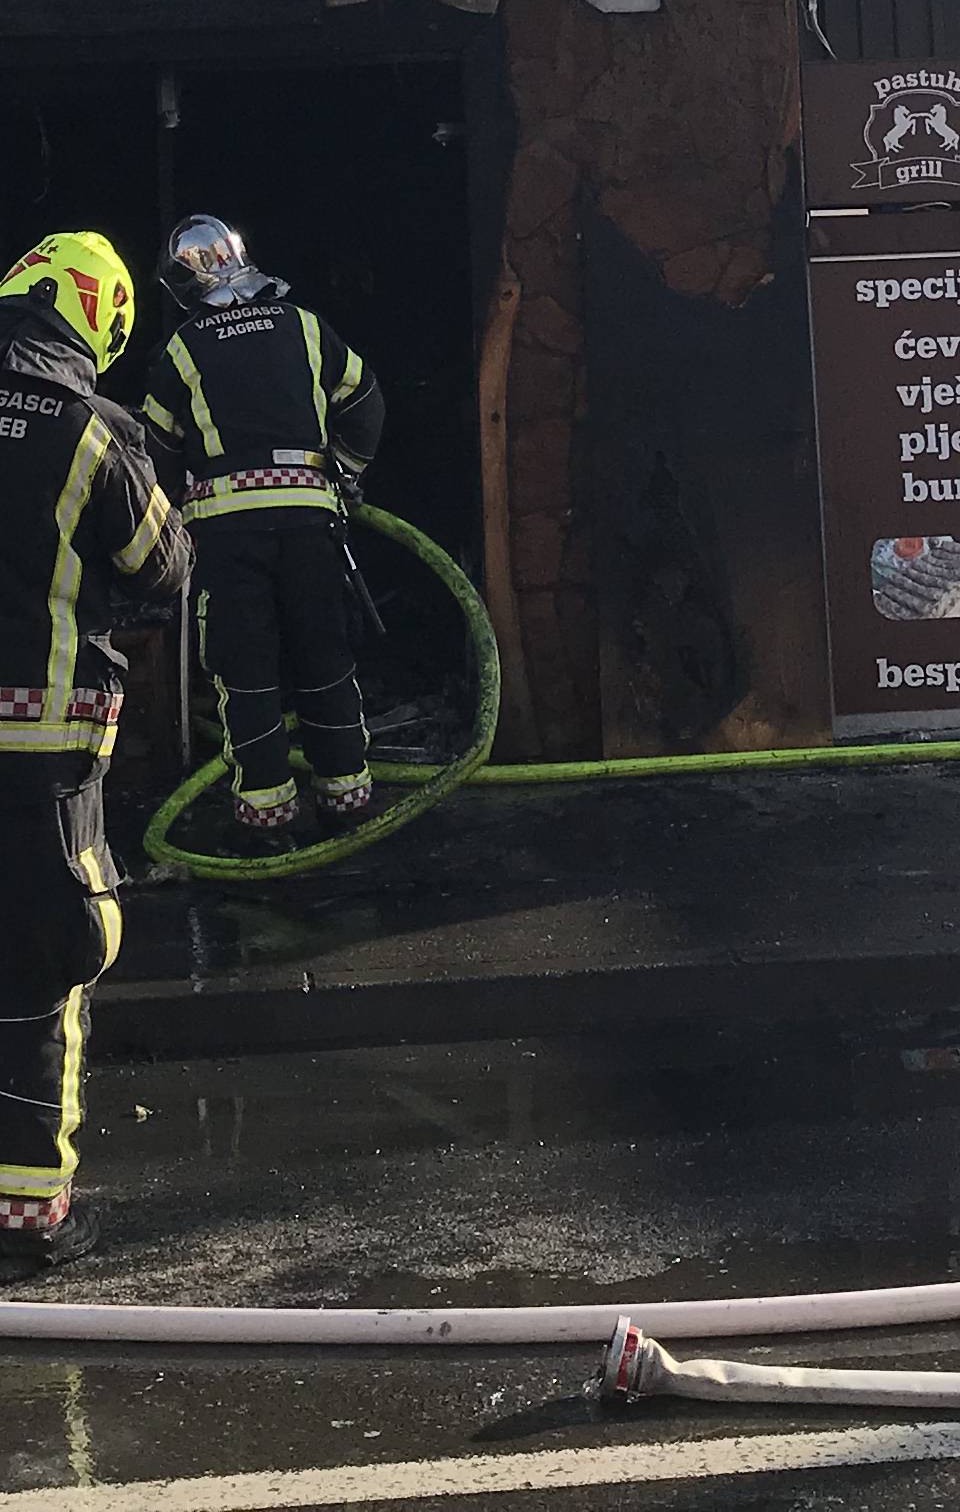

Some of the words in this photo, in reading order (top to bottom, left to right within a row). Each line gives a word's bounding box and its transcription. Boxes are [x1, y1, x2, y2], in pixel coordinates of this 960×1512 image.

[896, 161, 942, 183] grill
[855, 269, 960, 308] speci
[195, 306, 285, 330] VATROGASCI
[216, 319, 275, 340] ZAGREB
[894, 330, 960, 360] ćev
[896, 377, 960, 414] vje
